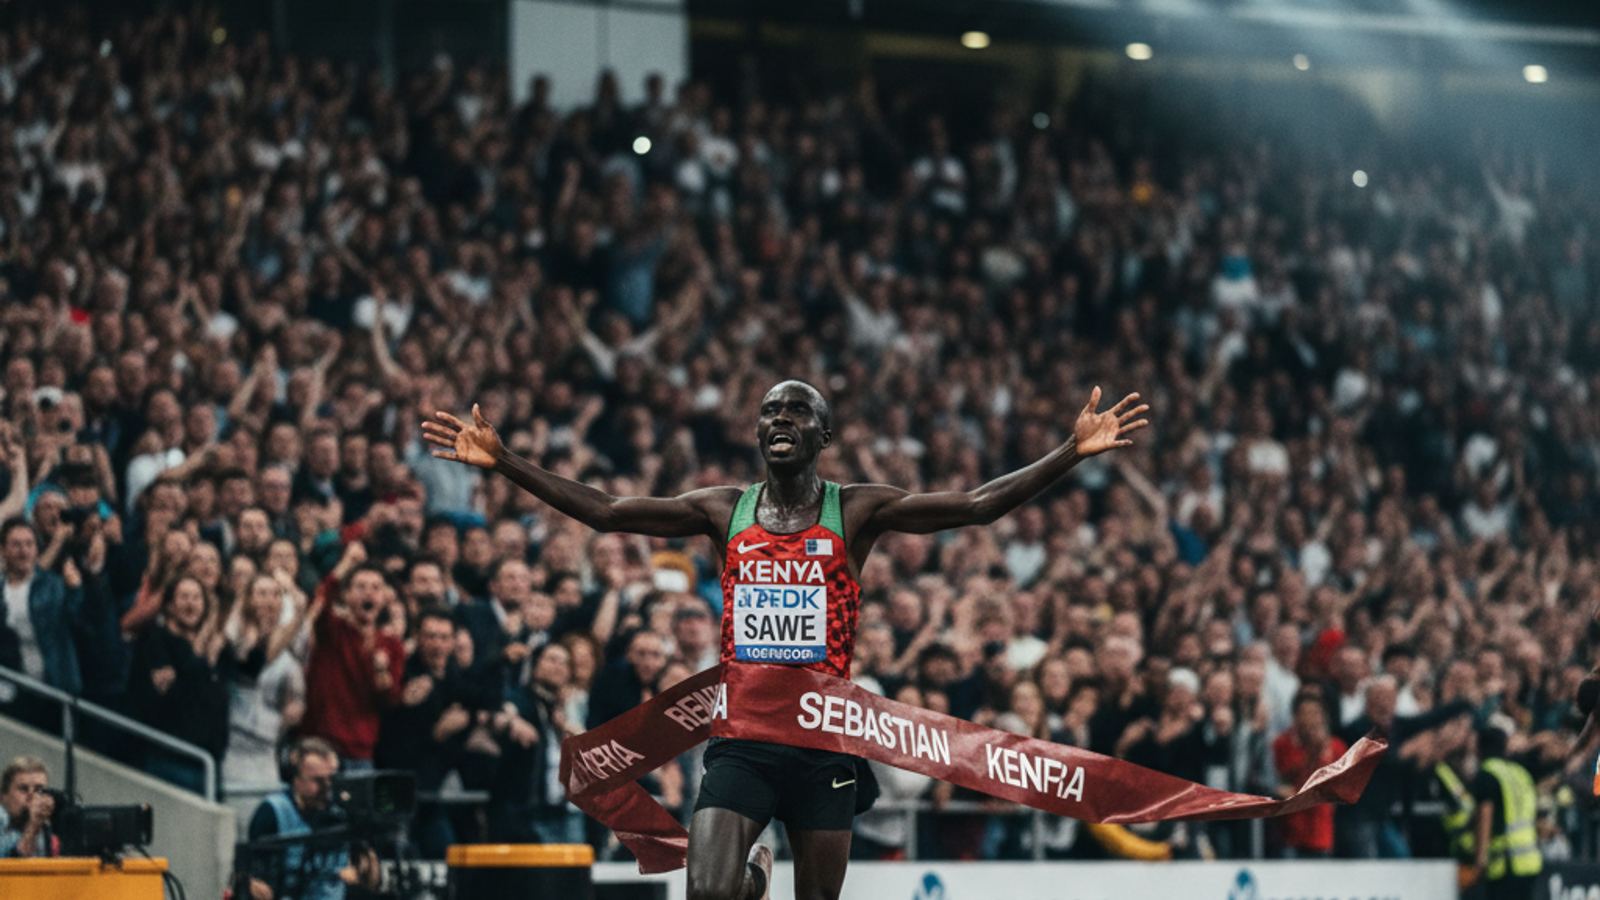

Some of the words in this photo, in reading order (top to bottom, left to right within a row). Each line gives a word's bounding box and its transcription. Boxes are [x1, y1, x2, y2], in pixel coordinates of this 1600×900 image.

[739, 560, 826, 583] KENYA
[744, 614, 816, 641] SAWE
[797, 691, 951, 765] SEBASTIAN
